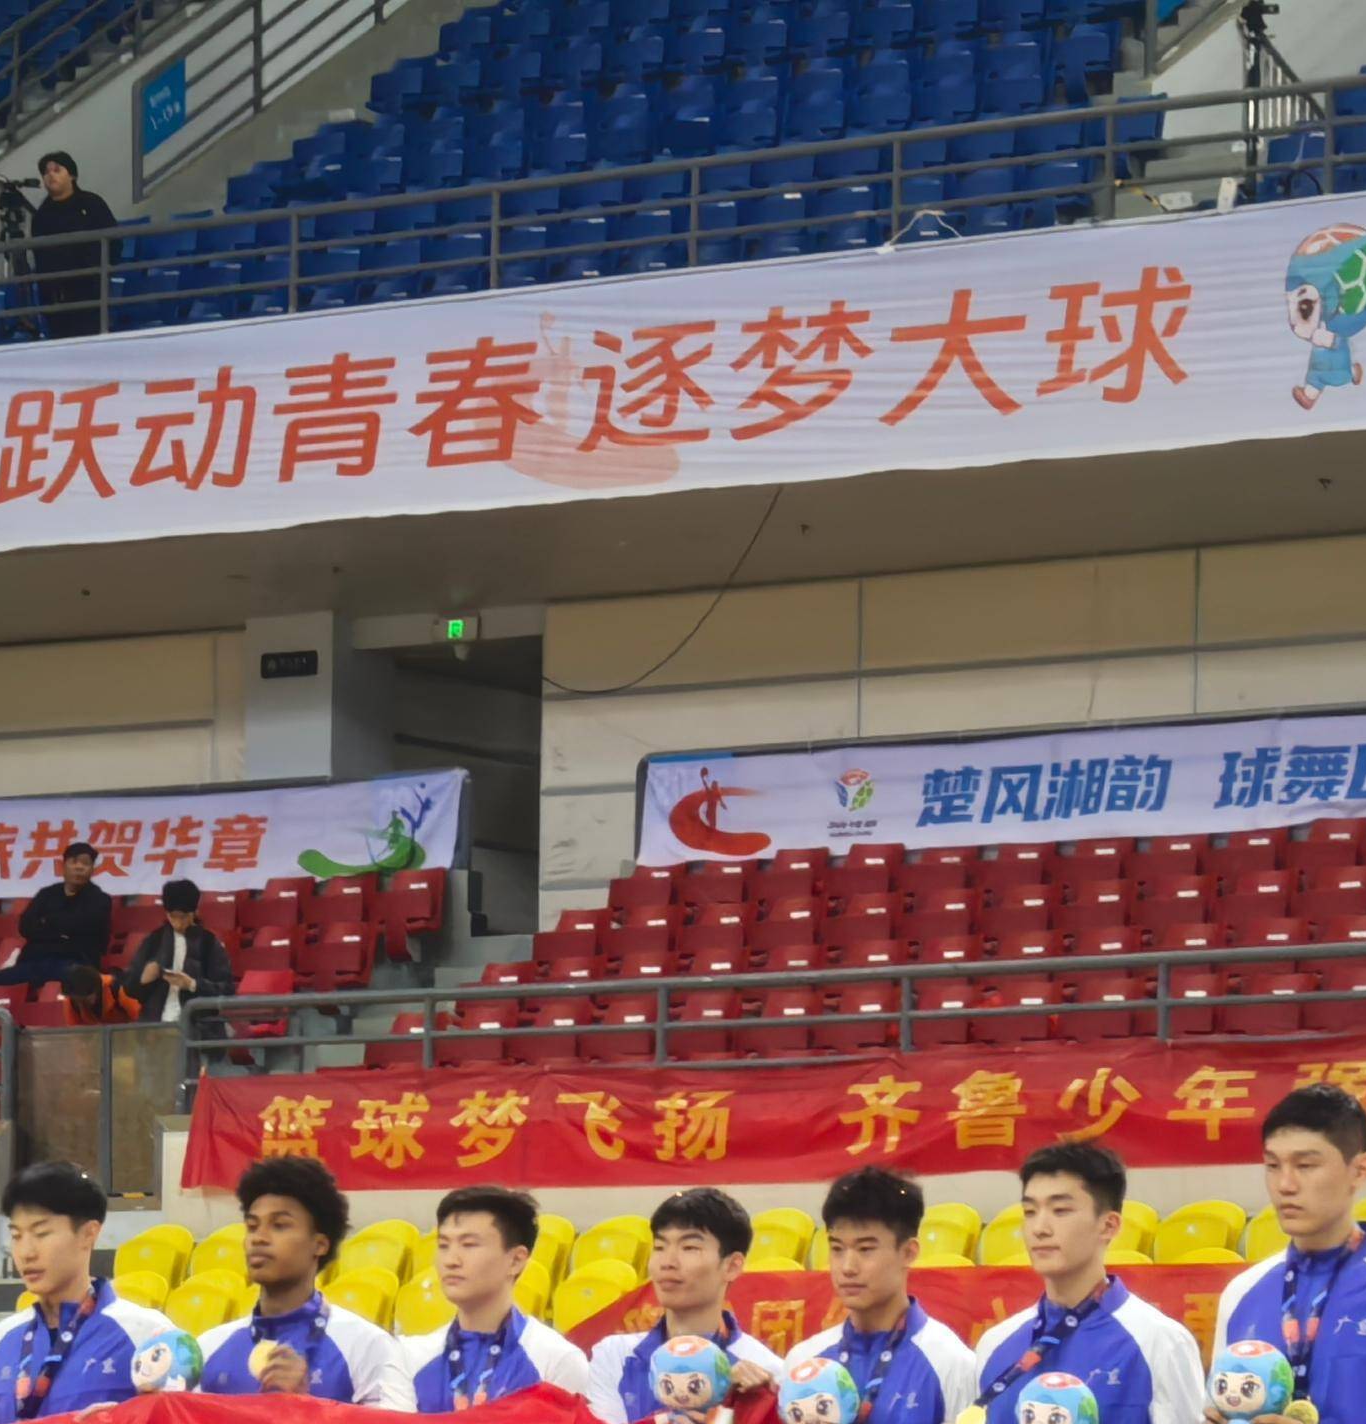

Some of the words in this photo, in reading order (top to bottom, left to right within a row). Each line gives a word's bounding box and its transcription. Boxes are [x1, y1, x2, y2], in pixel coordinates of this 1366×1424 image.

[576, 265, 1193, 454] 逐梦大球
[915, 753, 1173, 827] 楚风湘韵
[259, 1090, 735, 1169] 篮球梦飞扬
